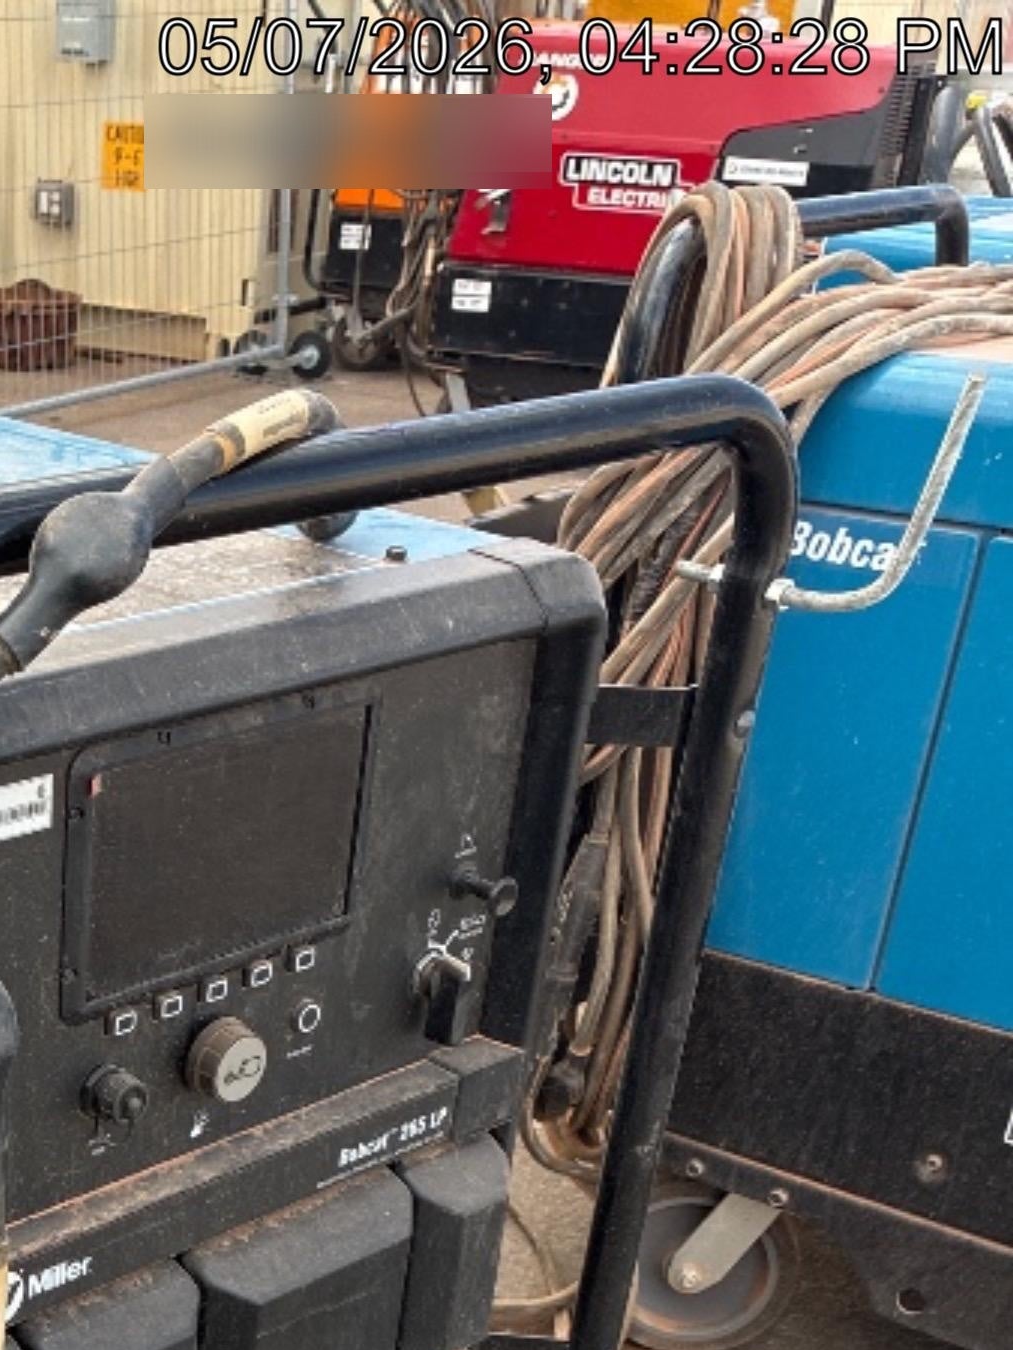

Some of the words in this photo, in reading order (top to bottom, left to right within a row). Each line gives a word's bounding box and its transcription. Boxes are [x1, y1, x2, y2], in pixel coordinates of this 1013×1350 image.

[566, 158, 673, 186] LINCOLN
[588, 186, 674, 209] ELECTRI
[790, 520, 927, 571] Bobca
[27, 1256, 93, 1298] Miller
